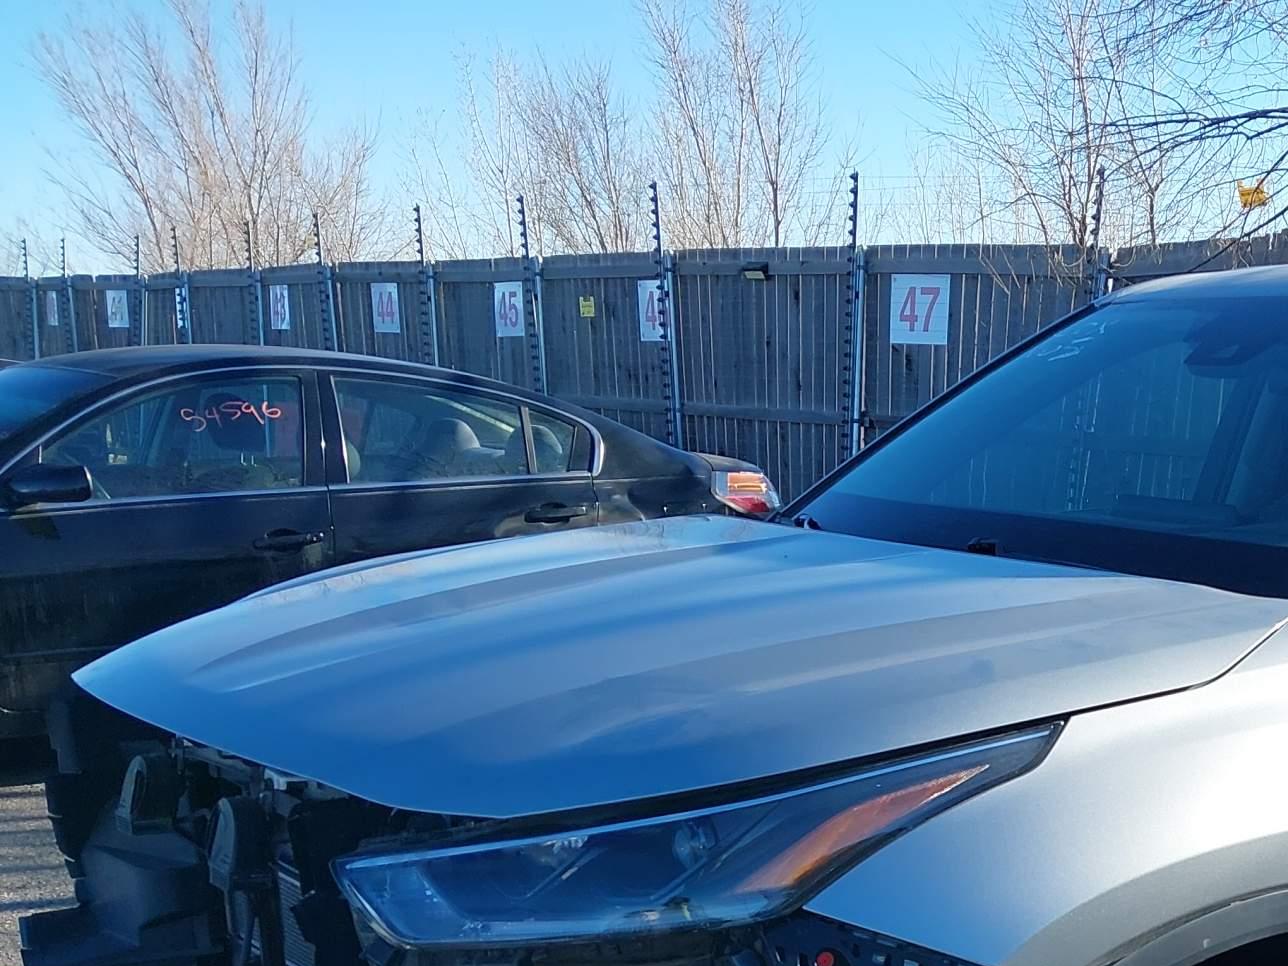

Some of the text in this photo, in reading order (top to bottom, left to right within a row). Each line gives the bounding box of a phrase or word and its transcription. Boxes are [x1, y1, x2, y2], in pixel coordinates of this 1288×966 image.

[377, 291, 396, 324] 44
[500, 291, 519, 328] 45
[900, 287, 940, 332] 47
[181, 401, 281, 432] 54596
